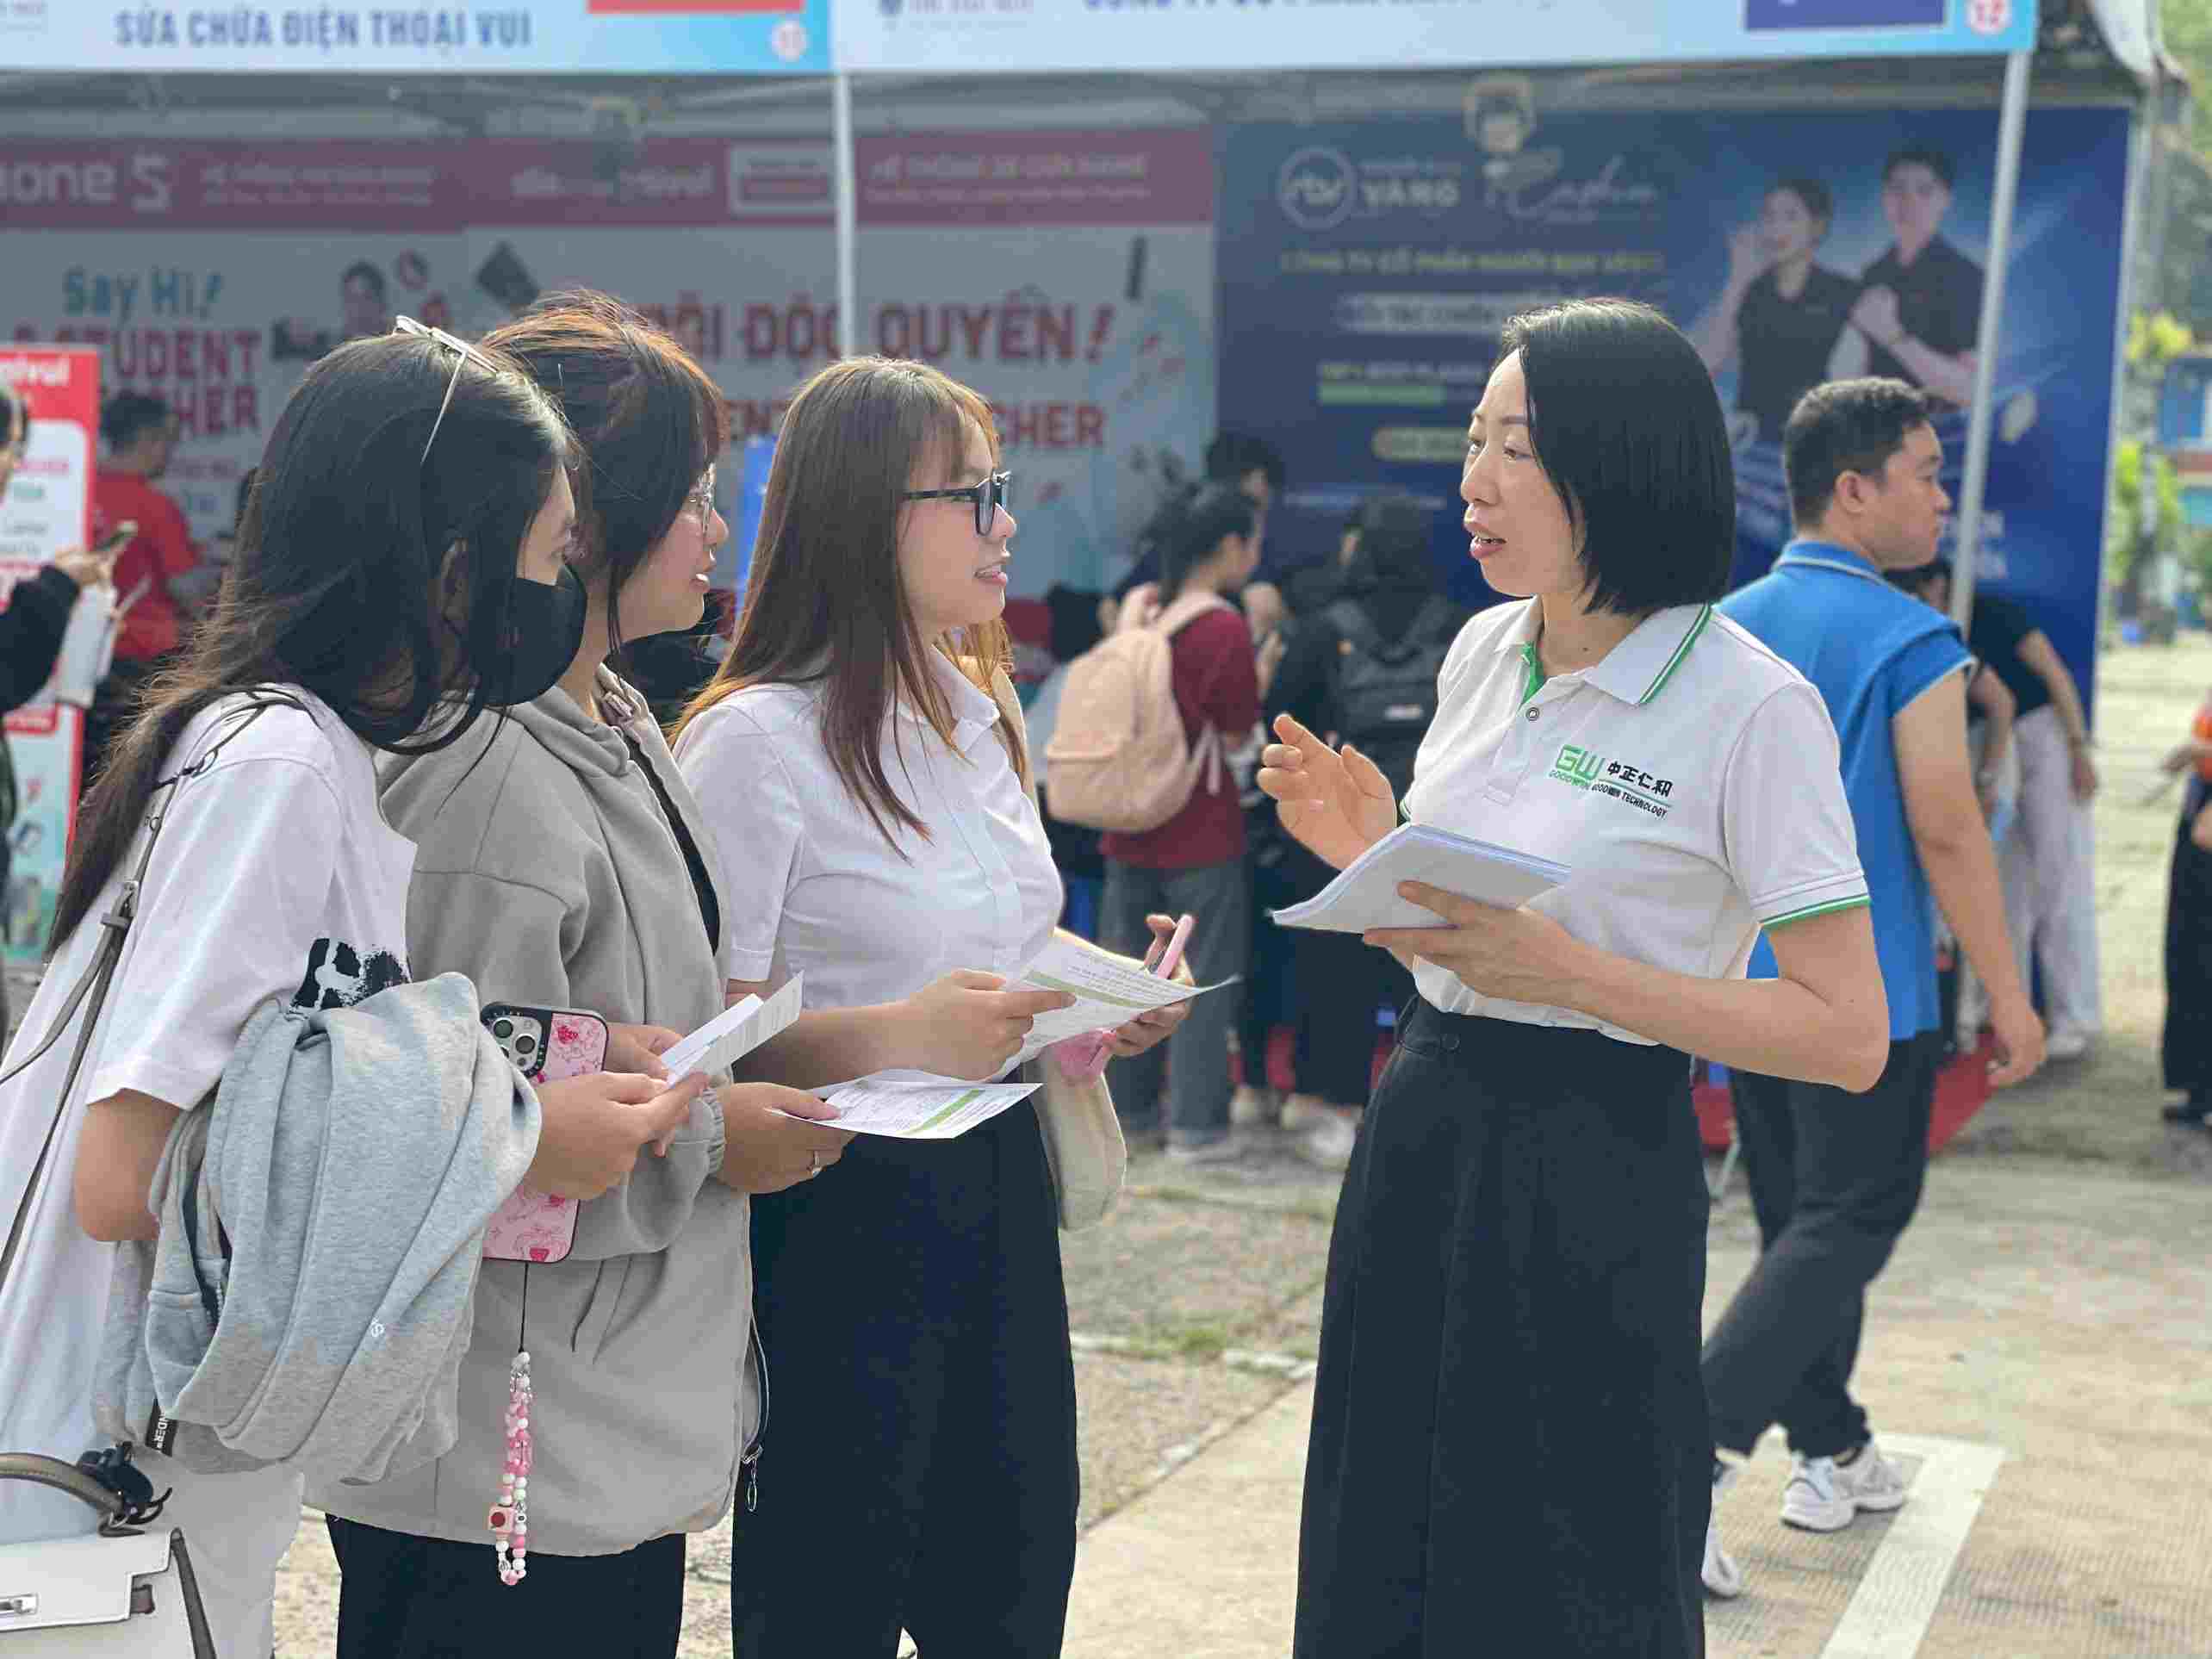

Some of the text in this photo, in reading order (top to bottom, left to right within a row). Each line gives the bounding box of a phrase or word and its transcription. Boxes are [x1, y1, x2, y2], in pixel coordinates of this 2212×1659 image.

[476, 9, 532, 47] VUI
[63, 265, 224, 321] Say Hi!
[1621, 791, 1668, 819] TECHNOLOGY
